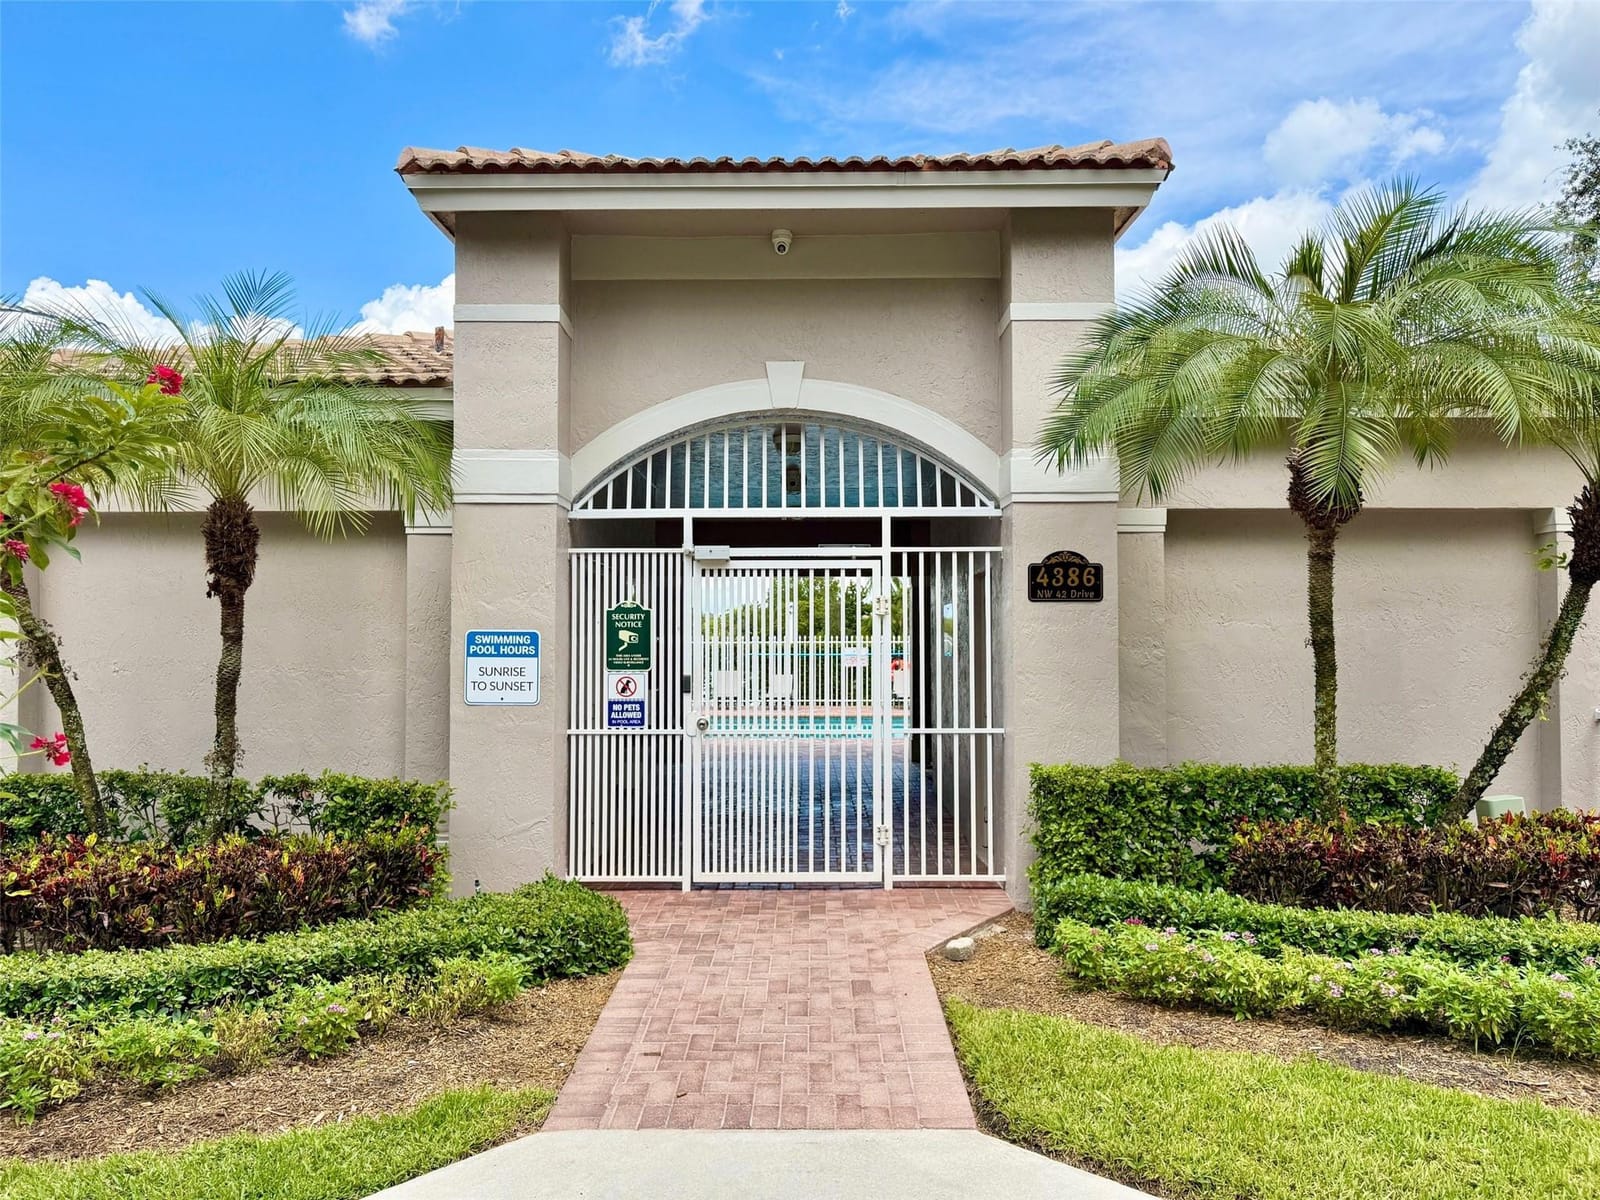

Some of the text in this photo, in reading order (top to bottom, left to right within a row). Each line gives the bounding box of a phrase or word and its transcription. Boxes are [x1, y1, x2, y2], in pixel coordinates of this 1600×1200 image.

[1036, 566, 1095, 587] 4386
[1036, 589, 1095, 598] NW 42 Drive
[474, 634, 531, 644] SWIMMING
[469, 645, 536, 655] POOL HOURS
[478, 666, 526, 677] SUNRISE
[470, 681, 534, 692] TO SUNSET
[612, 703, 641, 711] NO PETS
[610, 711, 642, 719] ALLOWED
